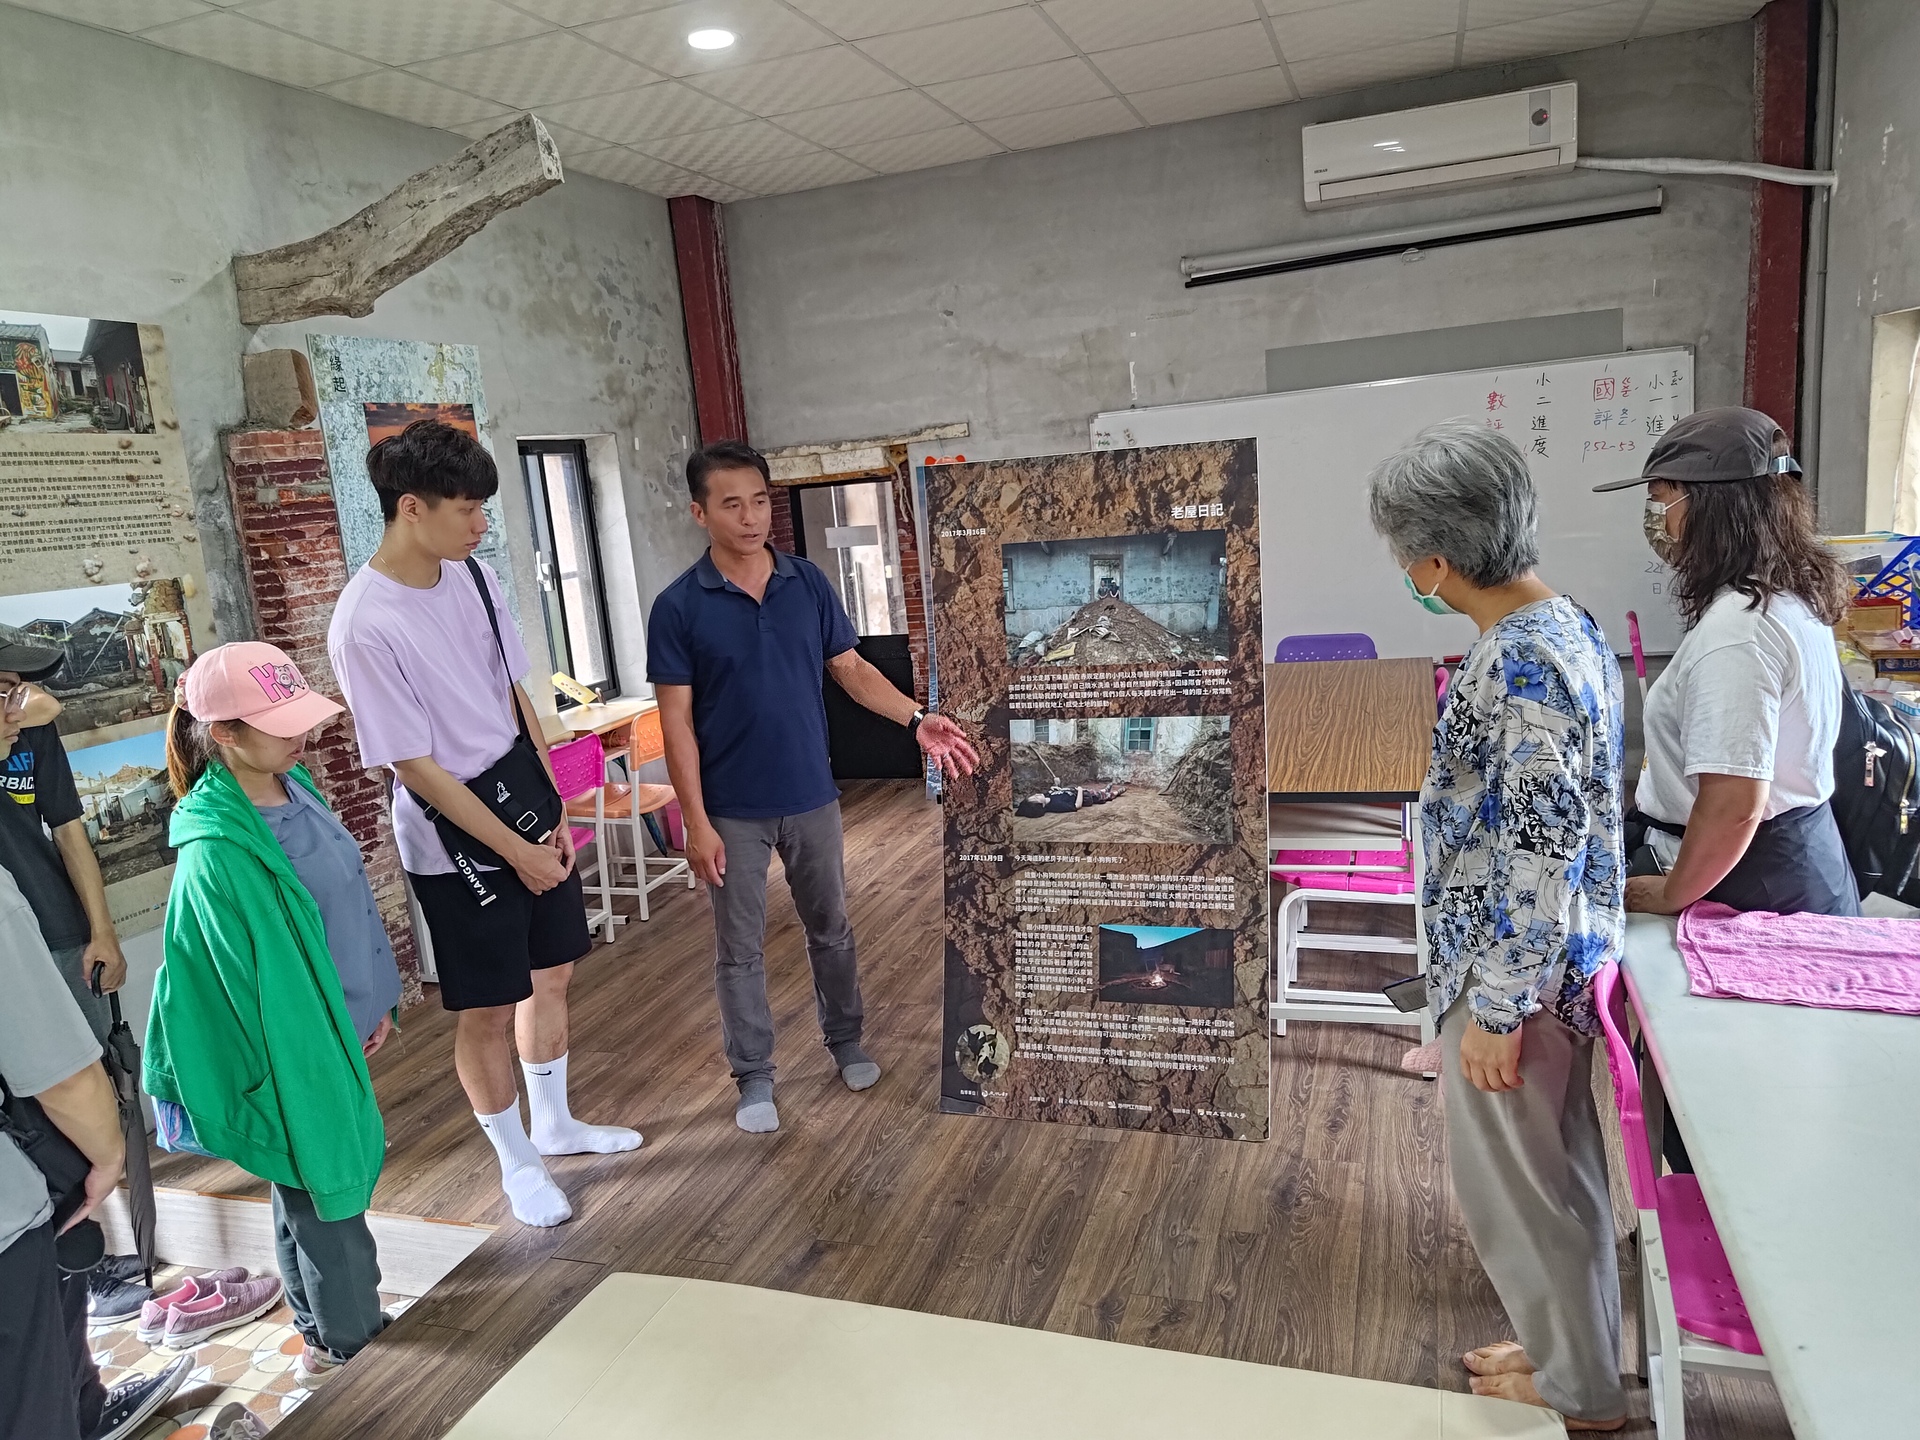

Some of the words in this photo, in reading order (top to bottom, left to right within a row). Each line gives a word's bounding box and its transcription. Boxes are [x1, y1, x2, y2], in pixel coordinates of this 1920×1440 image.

[330, 355, 346, 392] 緣起
[1531, 372, 1551, 458] 小二進度
[1171, 503, 1224, 519] 老屋日記
[941, 528, 987, 537] 2017年3月16日
[959, 854, 1003, 862] 2017年11月9日
[454, 852, 487, 896] KANGOL
